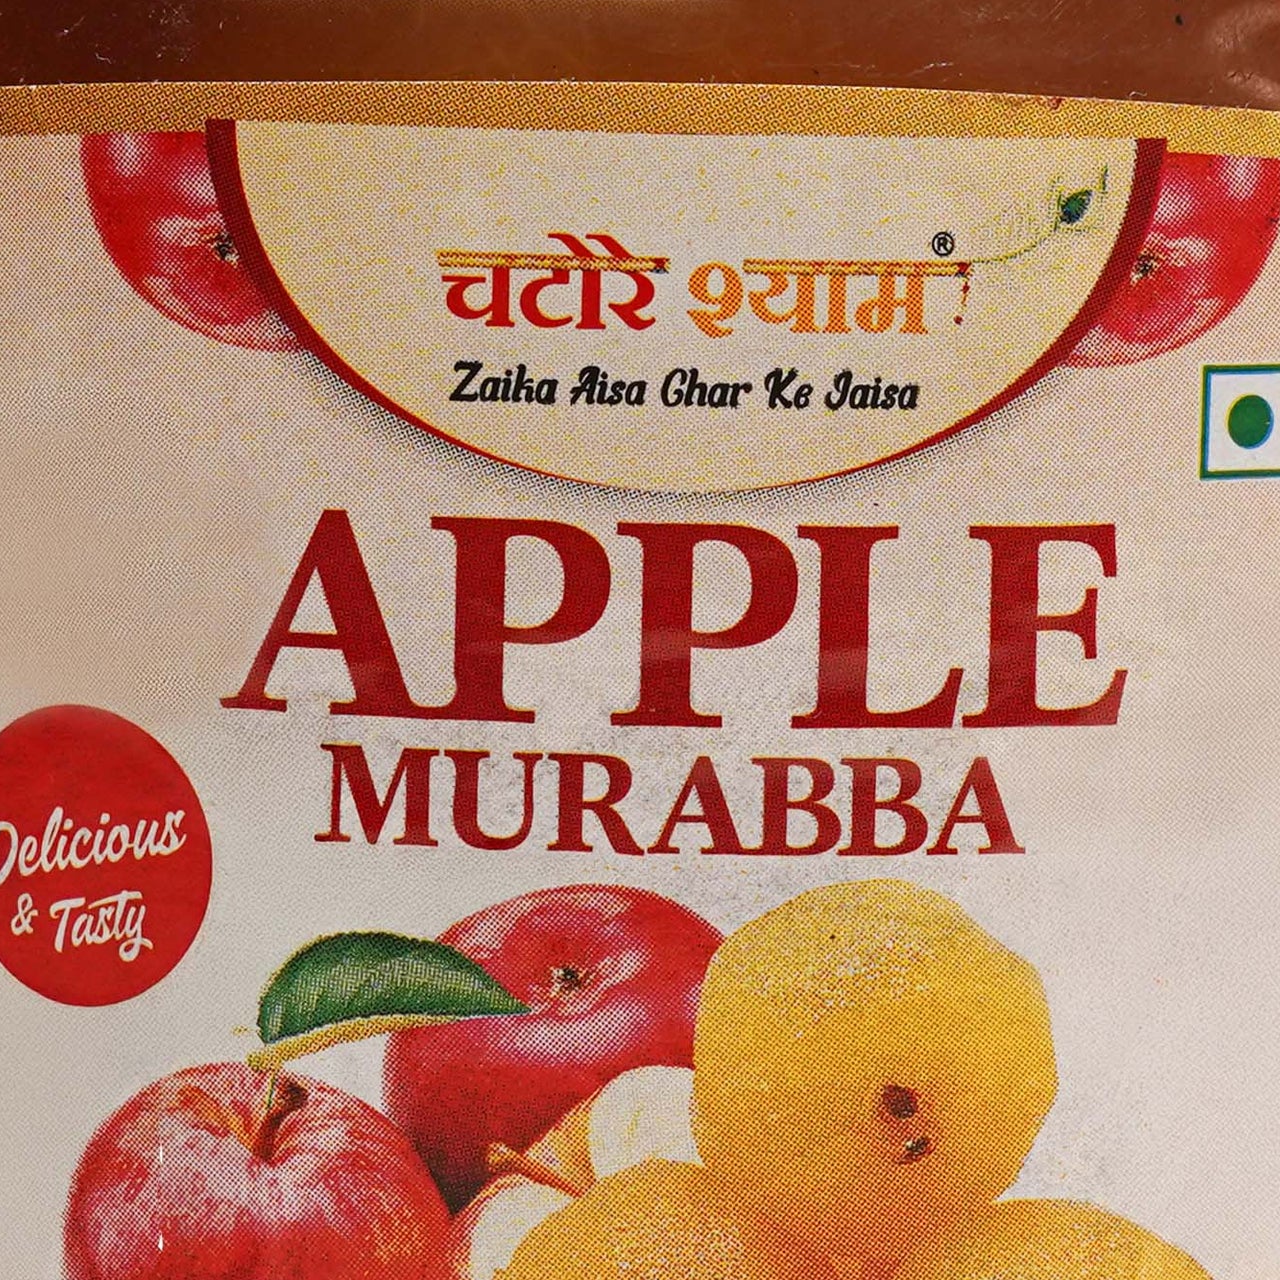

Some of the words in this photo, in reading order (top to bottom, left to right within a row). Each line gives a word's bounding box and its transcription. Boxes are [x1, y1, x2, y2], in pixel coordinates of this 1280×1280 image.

[436, 232, 670, 331] चटोरे
[686, 257, 938, 339] श्याम
[448, 360, 558, 404] Zaika
[569, 365, 647, 407] Aisa
[660, 367, 753, 409] Ghar
[764, 366, 813, 410] Ke
[824, 368, 919, 411] Jaisa
[219, 508, 1129, 729] APPLE
[314, 742, 1027, 856] MURABBA
[10, 892, 39, 937] &
[49, 889, 154, 963] Tasty
